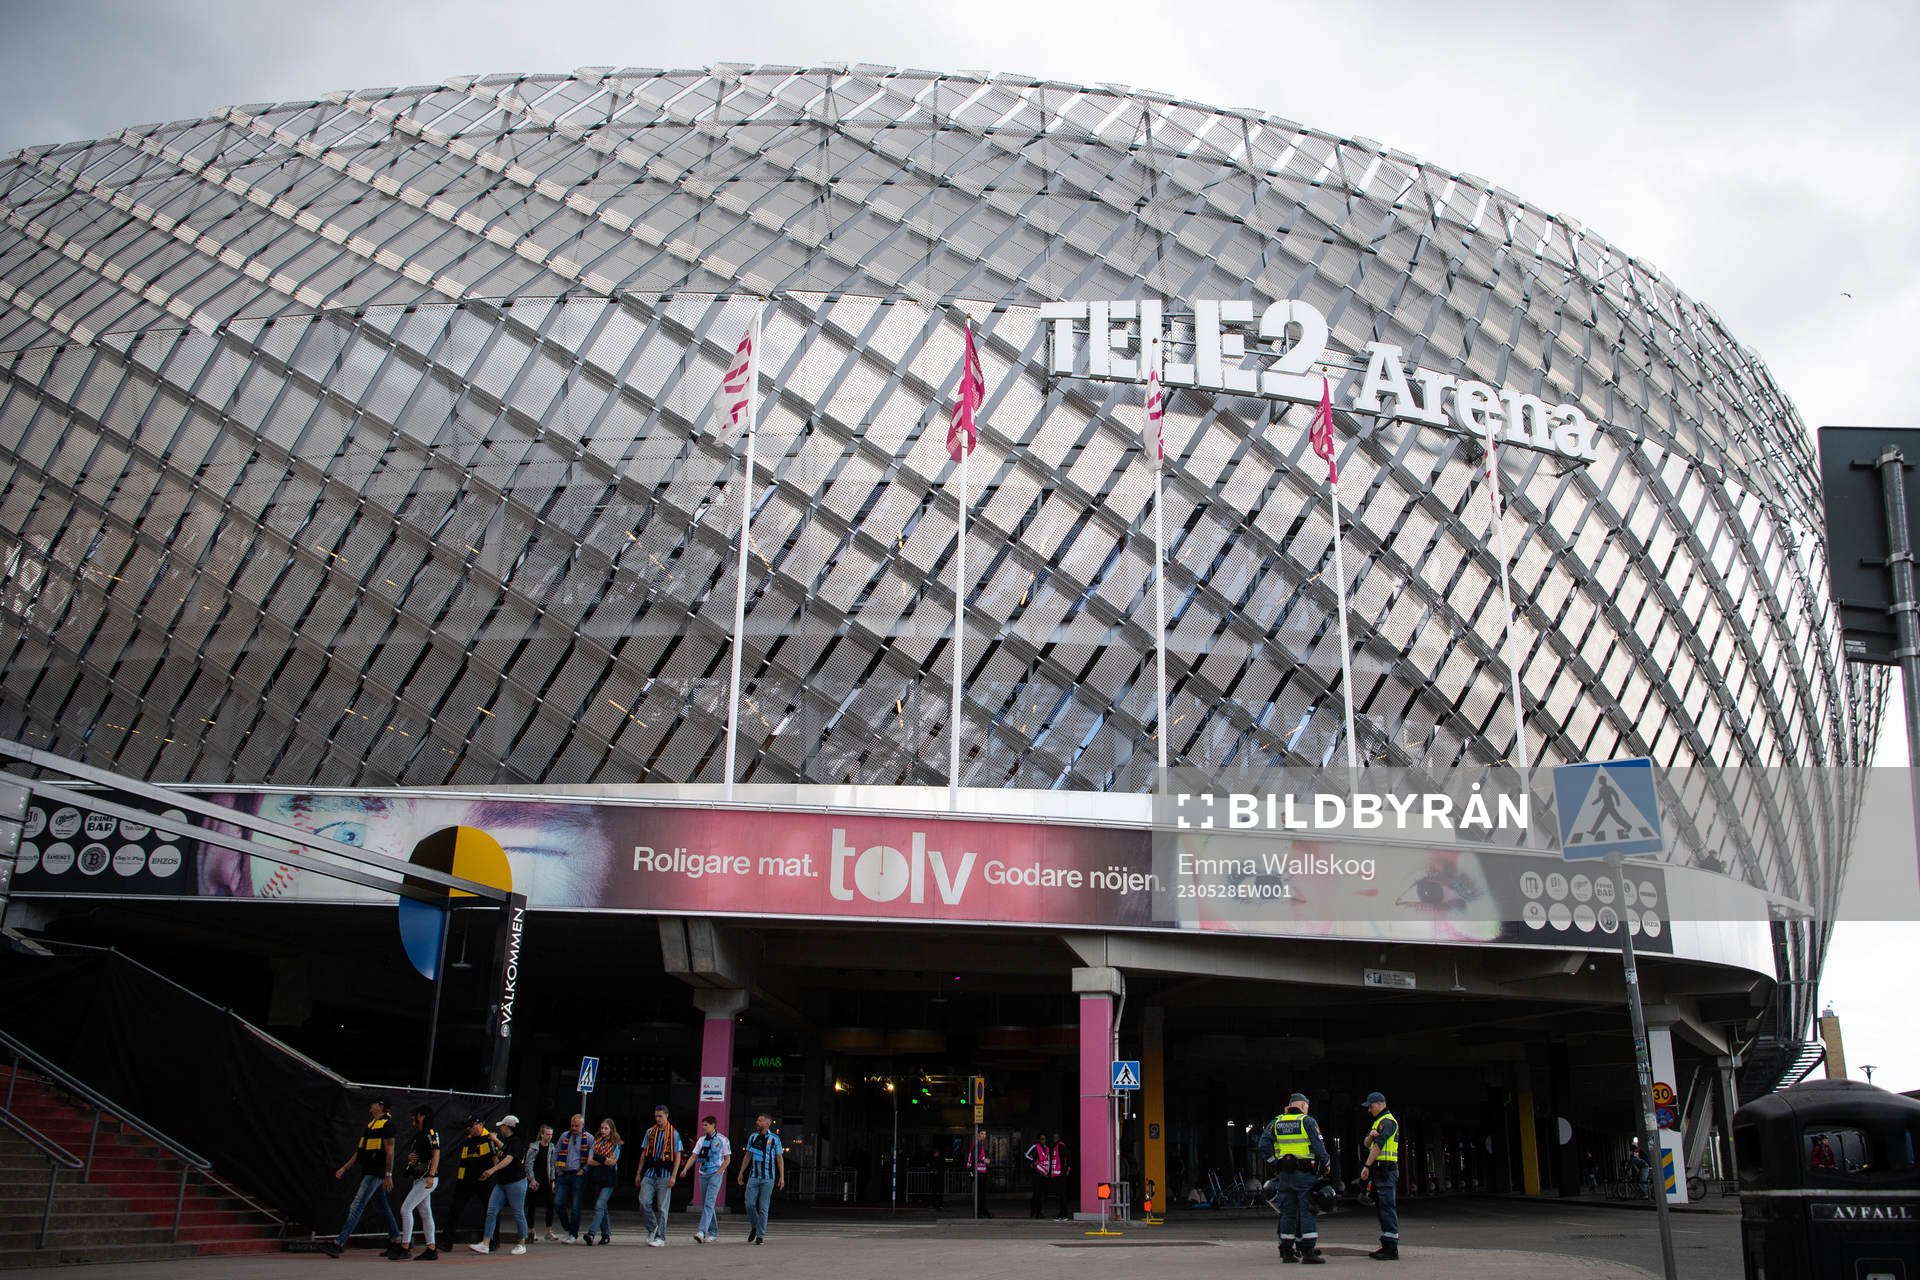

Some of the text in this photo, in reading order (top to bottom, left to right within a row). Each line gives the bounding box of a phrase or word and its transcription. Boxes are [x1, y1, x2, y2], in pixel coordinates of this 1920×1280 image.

[1040, 299, 1598, 464] TELE2 Arena
[87, 823, 113, 831] BAR
[633, 847, 819, 878] Roligare mat.
[830, 828, 977, 905] tolv
[983, 859, 1166, 894] Godare nöjen.
[1597, 889, 1614, 898] BAR
[501, 907, 525, 1025] VÄLKOMMEN
[1653, 1088, 1670, 1100] 30
[1834, 1207, 1912, 1219] AVFALL
